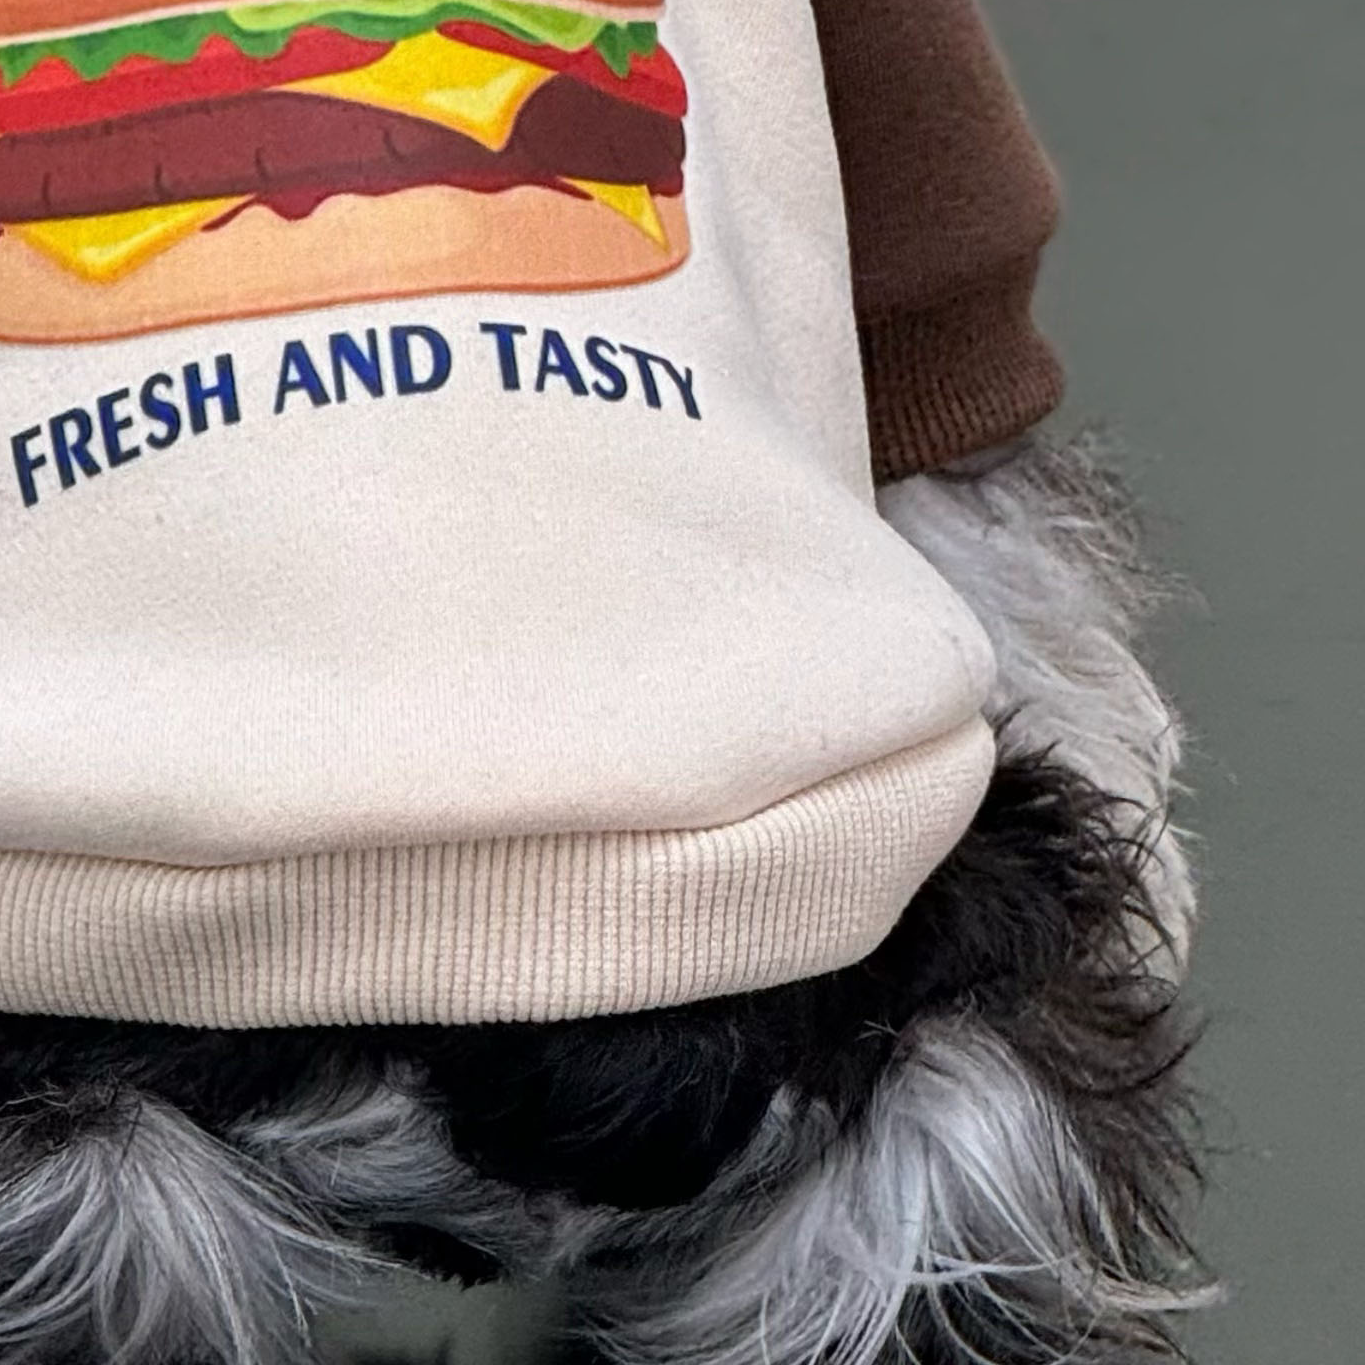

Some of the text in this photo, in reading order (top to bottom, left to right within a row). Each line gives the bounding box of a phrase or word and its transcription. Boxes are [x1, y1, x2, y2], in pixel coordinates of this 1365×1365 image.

[10, 321, 703, 508] FRESH AND TASTY
